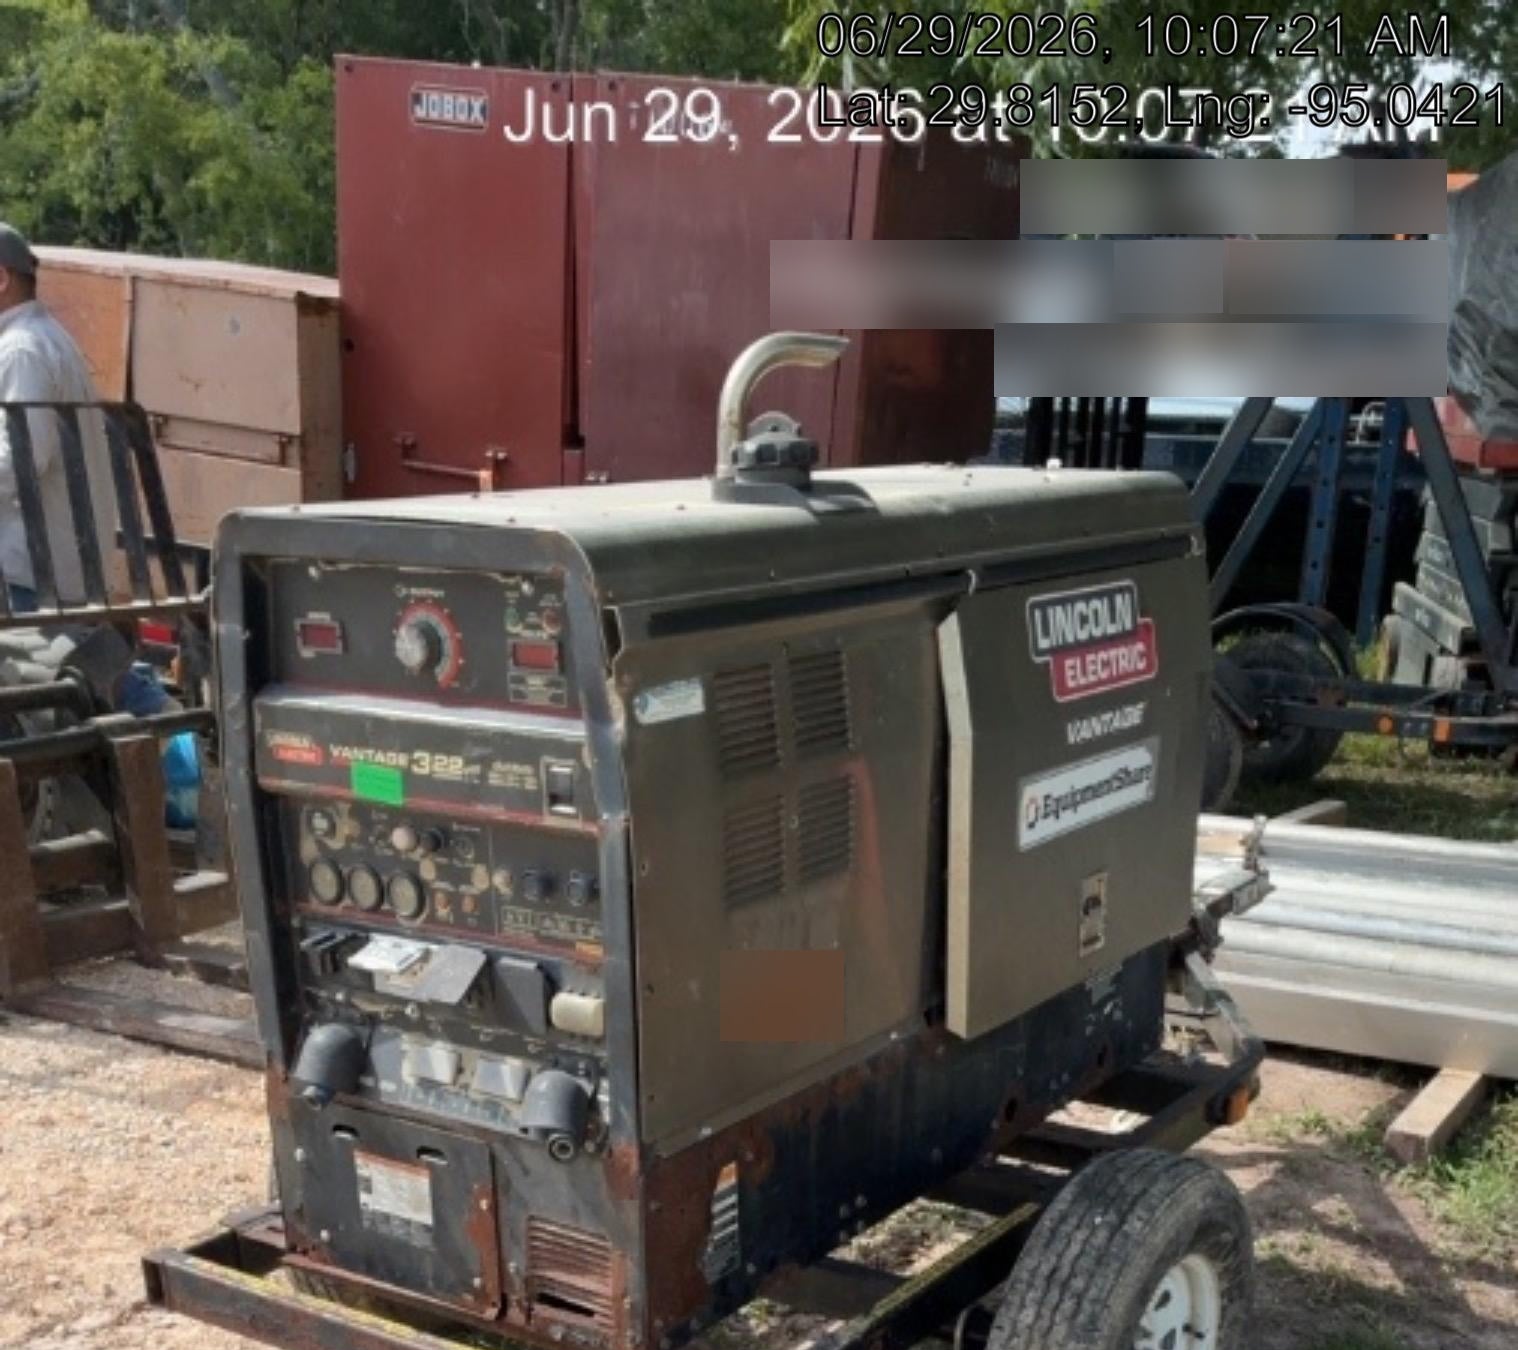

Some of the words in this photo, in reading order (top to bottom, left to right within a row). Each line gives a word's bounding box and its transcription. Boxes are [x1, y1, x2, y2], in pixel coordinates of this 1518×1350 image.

[413, 91, 485, 124] JOBOX
[1034, 592, 1133, 649] LINCOLN
[1064, 640, 1147, 688] ELECTRIC
[1067, 702, 1147, 744] VANTAGE
[410, 750, 464, 775] 322
